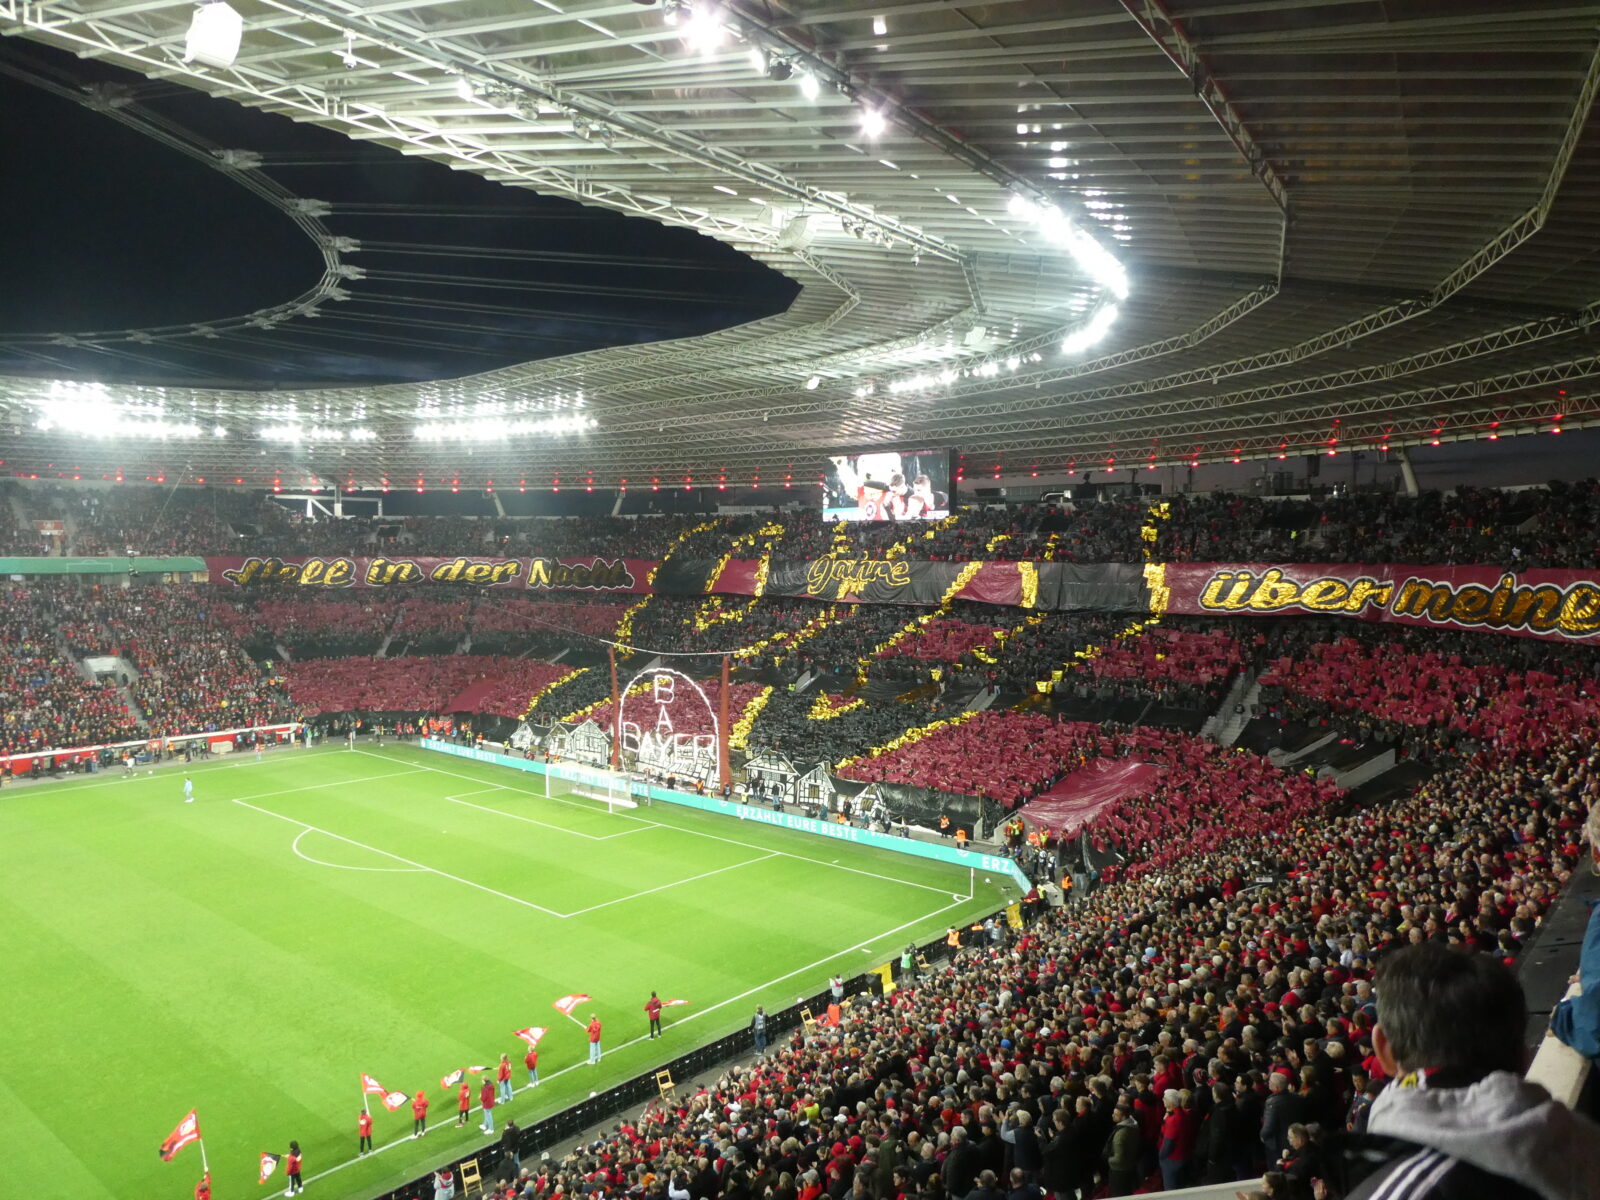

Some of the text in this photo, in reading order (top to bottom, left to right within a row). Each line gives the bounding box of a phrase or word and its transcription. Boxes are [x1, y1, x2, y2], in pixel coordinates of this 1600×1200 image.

[365, 557, 425, 587] in
[430, 557, 522, 586] der
[1200, 568, 1394, 612] über
[622, 721, 716, 765] BAYER
[787, 815, 818, 832] EURE
[821, 822, 859, 841] BESTE
